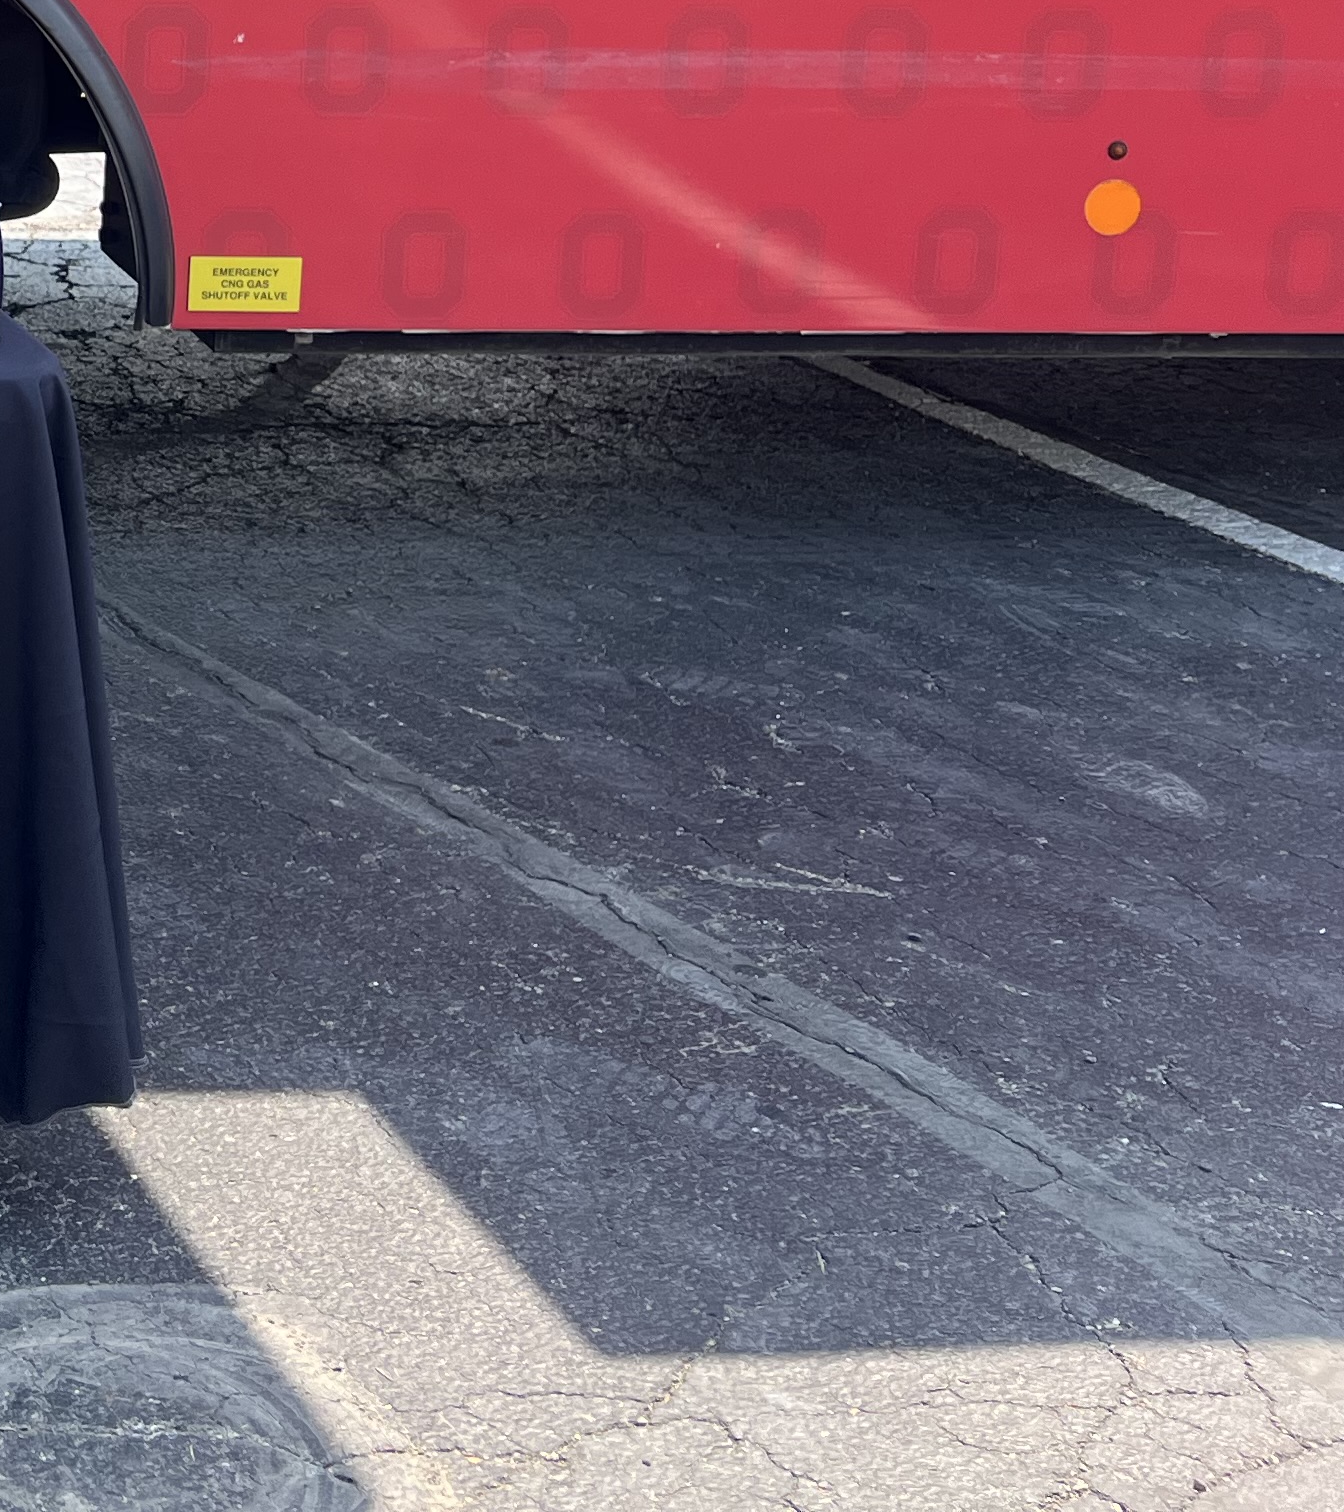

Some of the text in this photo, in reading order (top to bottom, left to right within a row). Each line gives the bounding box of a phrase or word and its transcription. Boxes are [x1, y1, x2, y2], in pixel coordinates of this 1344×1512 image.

[212, 267, 280, 277] EMERGENCY
[220, 279, 270, 289] CNG GAS
[201, 290, 288, 301] SHUTOFF VALVE
